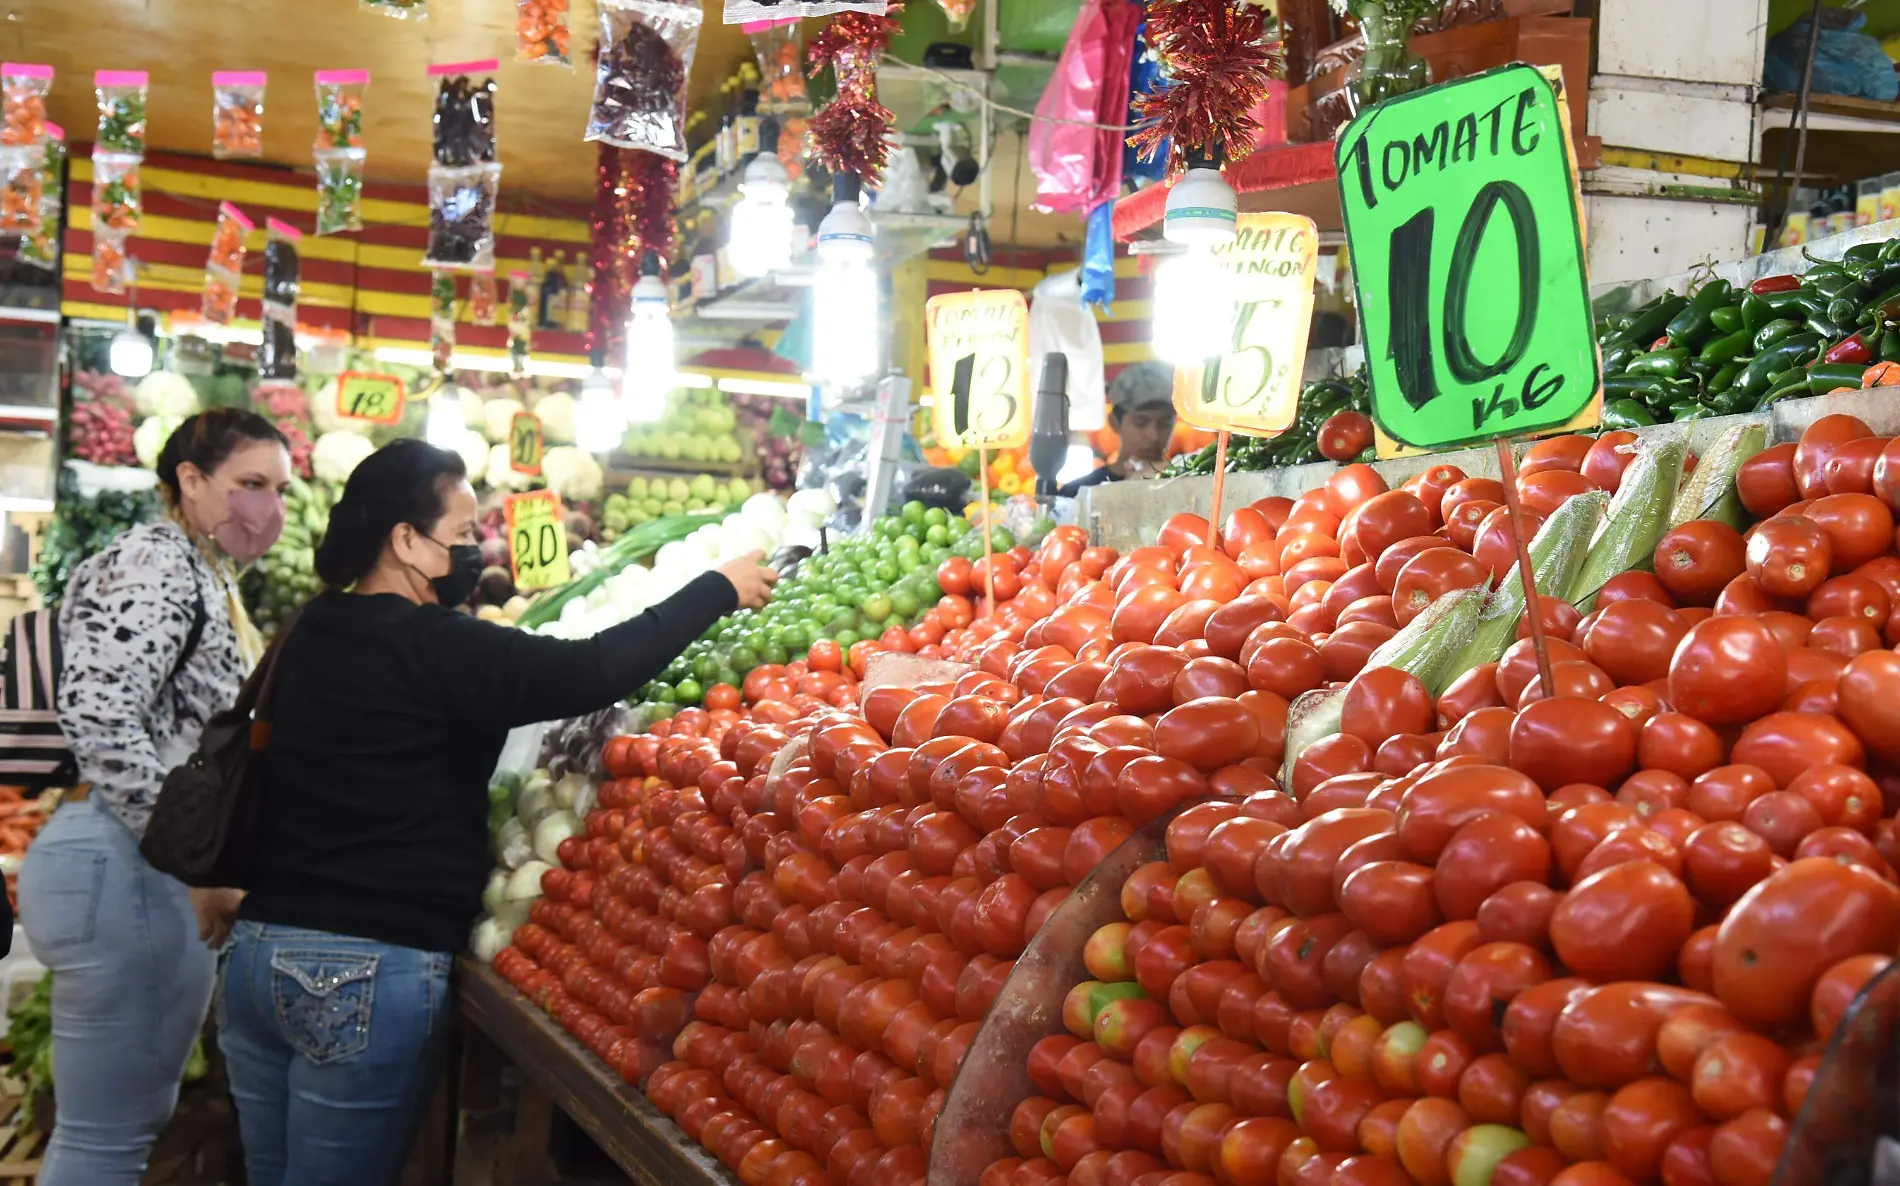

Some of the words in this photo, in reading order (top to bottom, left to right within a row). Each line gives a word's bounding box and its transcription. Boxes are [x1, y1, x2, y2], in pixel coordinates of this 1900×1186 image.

[1340, 87, 1540, 209] TOMATE
[1220, 252, 1313, 277] INGON
[1386, 180, 1541, 413] 10
[350, 392, 385, 418] 18
[950, 352, 1018, 437] 13
[1472, 363, 1566, 430] KG
[516, 524, 557, 573] 20
